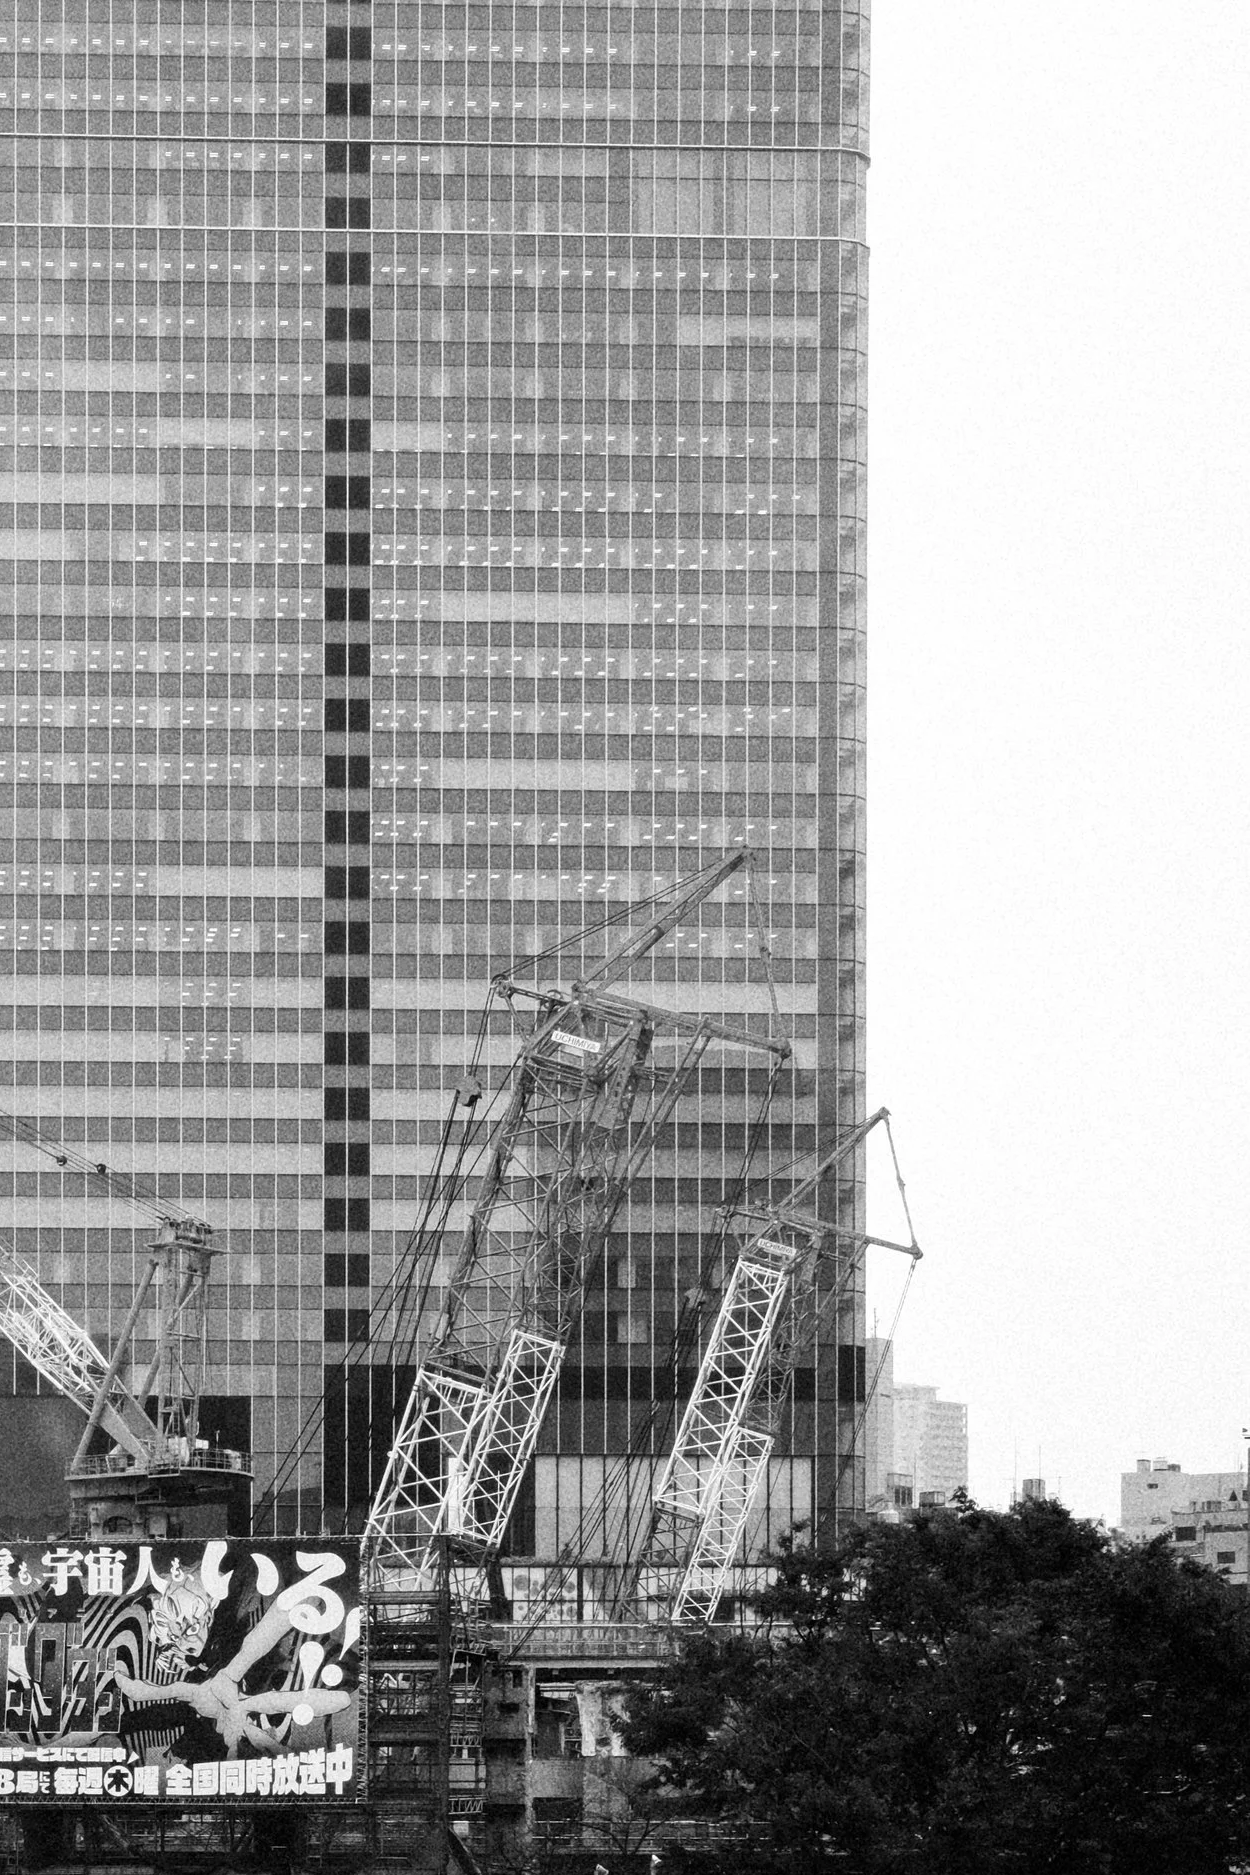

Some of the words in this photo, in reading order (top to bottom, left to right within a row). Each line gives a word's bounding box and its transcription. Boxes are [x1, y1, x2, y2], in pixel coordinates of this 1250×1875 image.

[166, 1743, 353, 1796] 全国同時放送中
